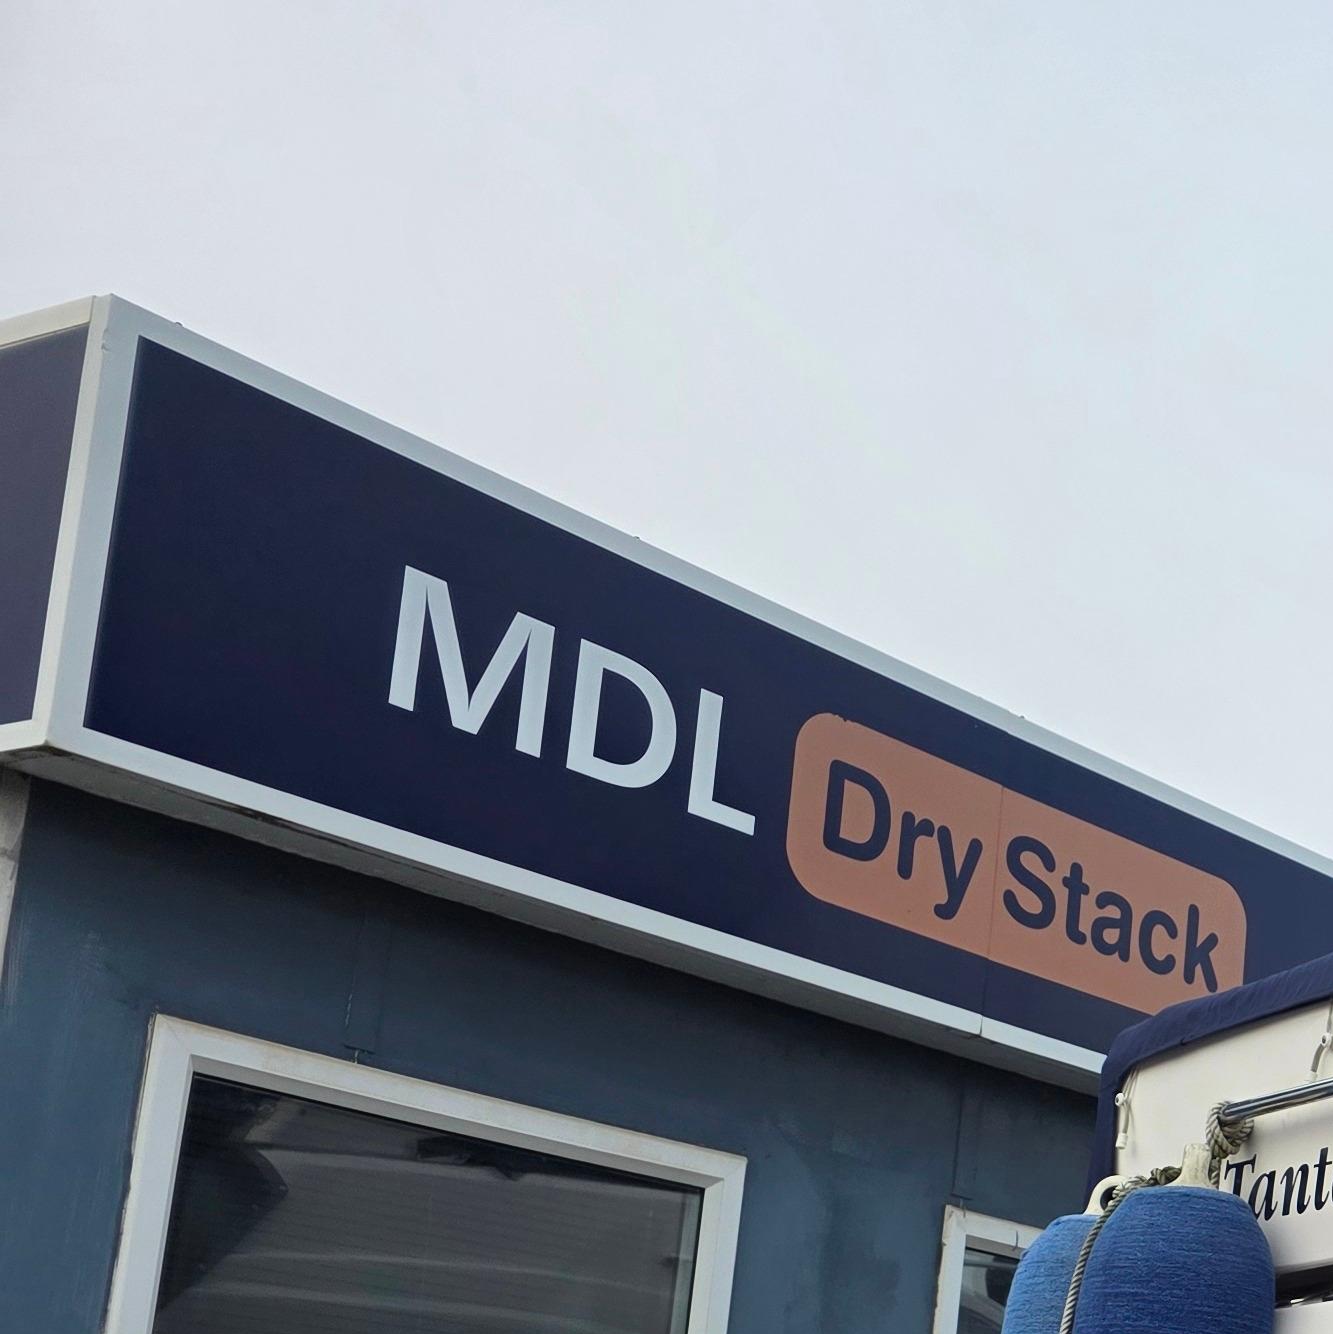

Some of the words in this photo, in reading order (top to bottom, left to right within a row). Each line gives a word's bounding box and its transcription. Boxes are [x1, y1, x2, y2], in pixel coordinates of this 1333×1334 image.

[388, 565, 756, 836] MDL
[822, 759, 984, 921] Dry
[1002, 835, 1219, 993] Stack
